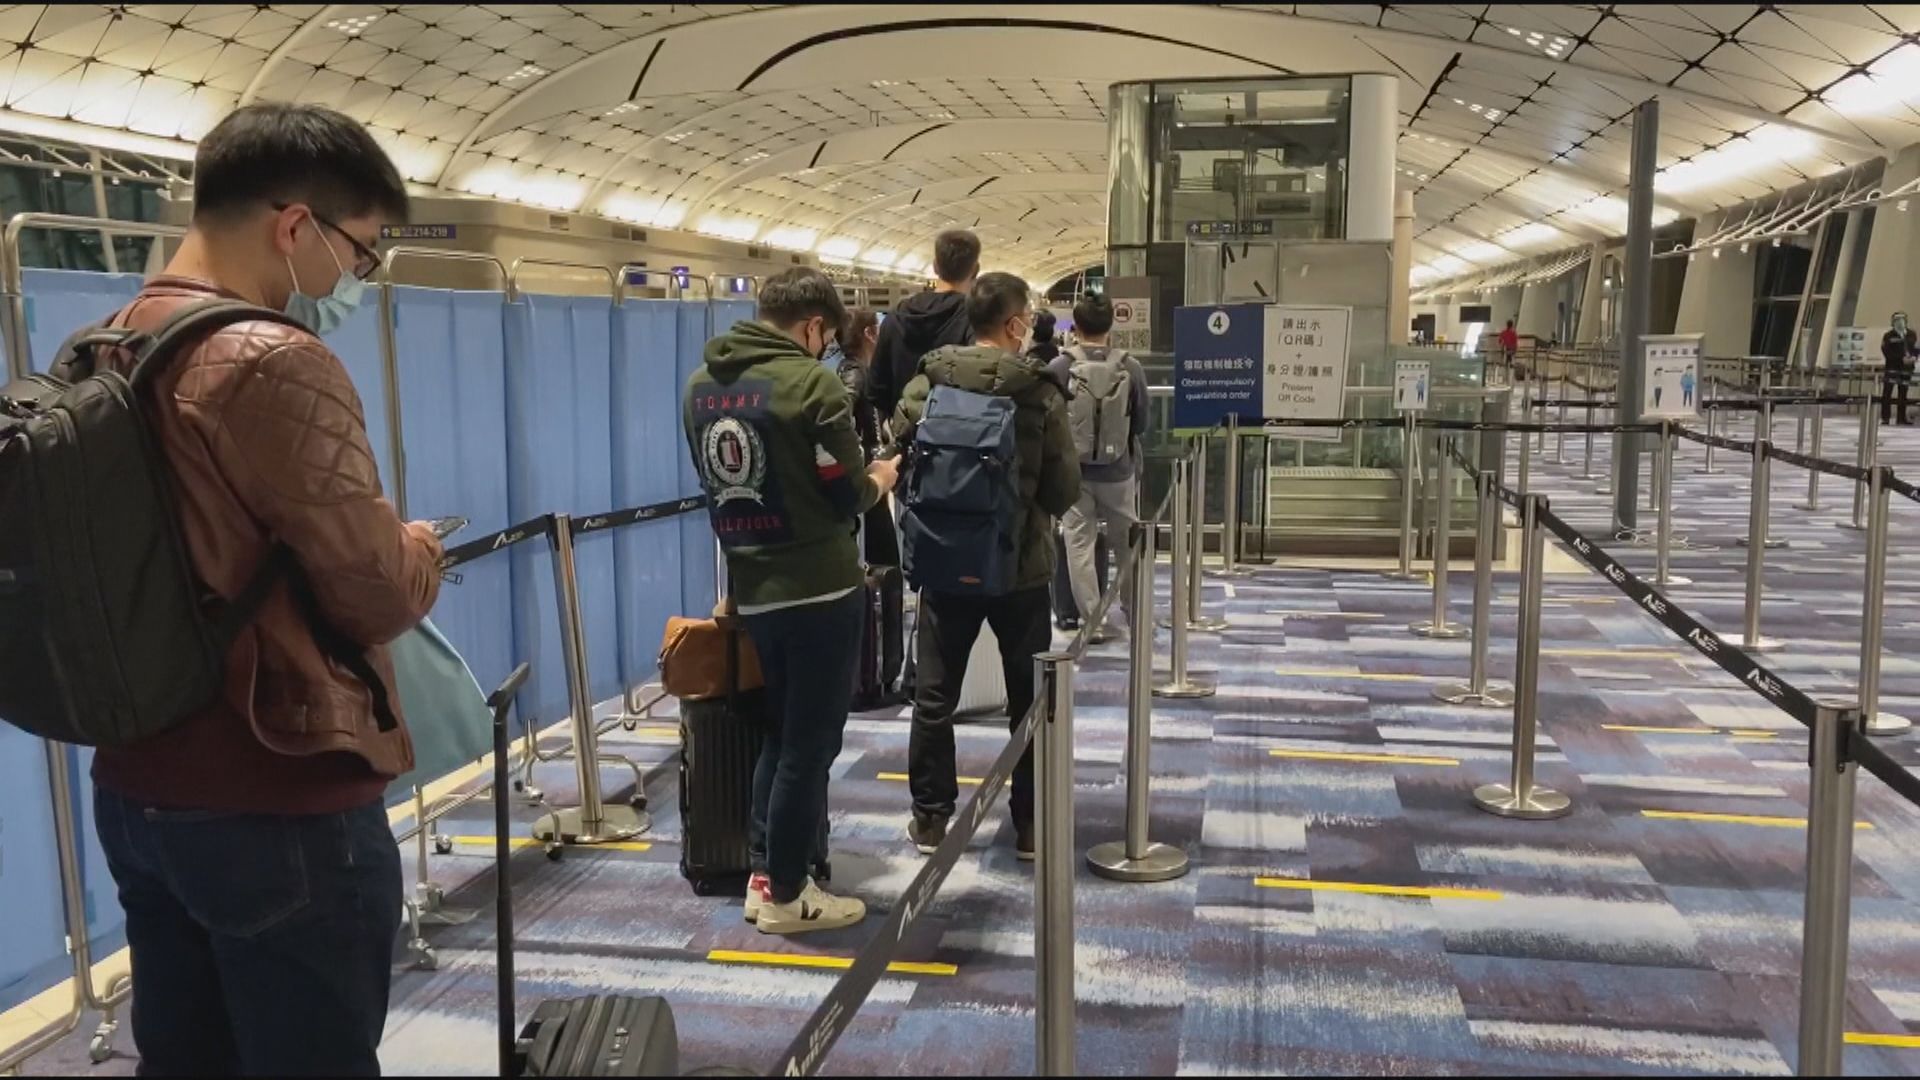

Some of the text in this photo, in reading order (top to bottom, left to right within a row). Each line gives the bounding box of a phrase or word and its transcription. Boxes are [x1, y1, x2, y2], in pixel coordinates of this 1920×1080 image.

[1213, 316, 1222, 330] 4
[1181, 378, 1256, 387] Obtain compulsory
[1185, 391, 1251, 401] quarantine order
[1294, 394, 1315, 403] Code
[695, 395, 761, 409] TOMMY
